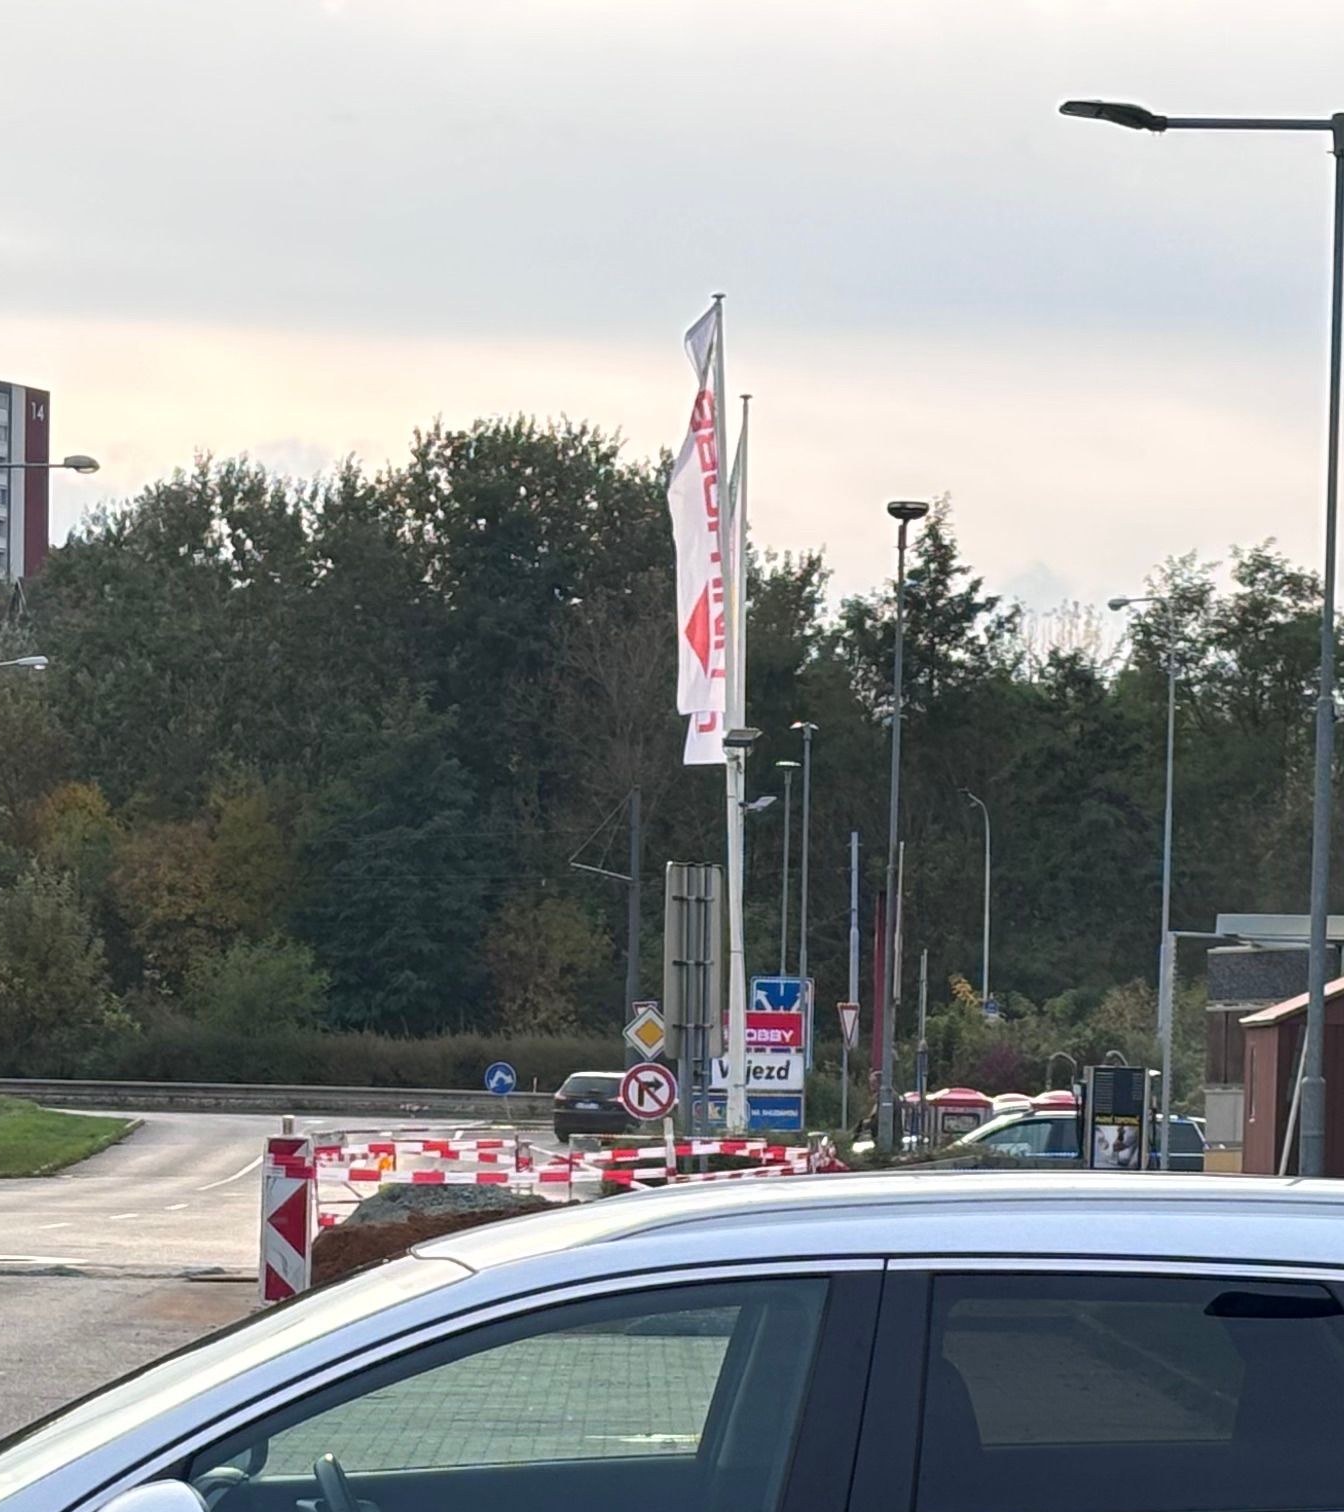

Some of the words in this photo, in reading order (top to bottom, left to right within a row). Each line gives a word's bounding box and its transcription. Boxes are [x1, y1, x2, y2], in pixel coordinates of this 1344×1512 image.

[31, 401, 44, 421] 14
[746, 1029, 793, 1042] OBBY
[718, 1059, 791, 1085] Vjezd
